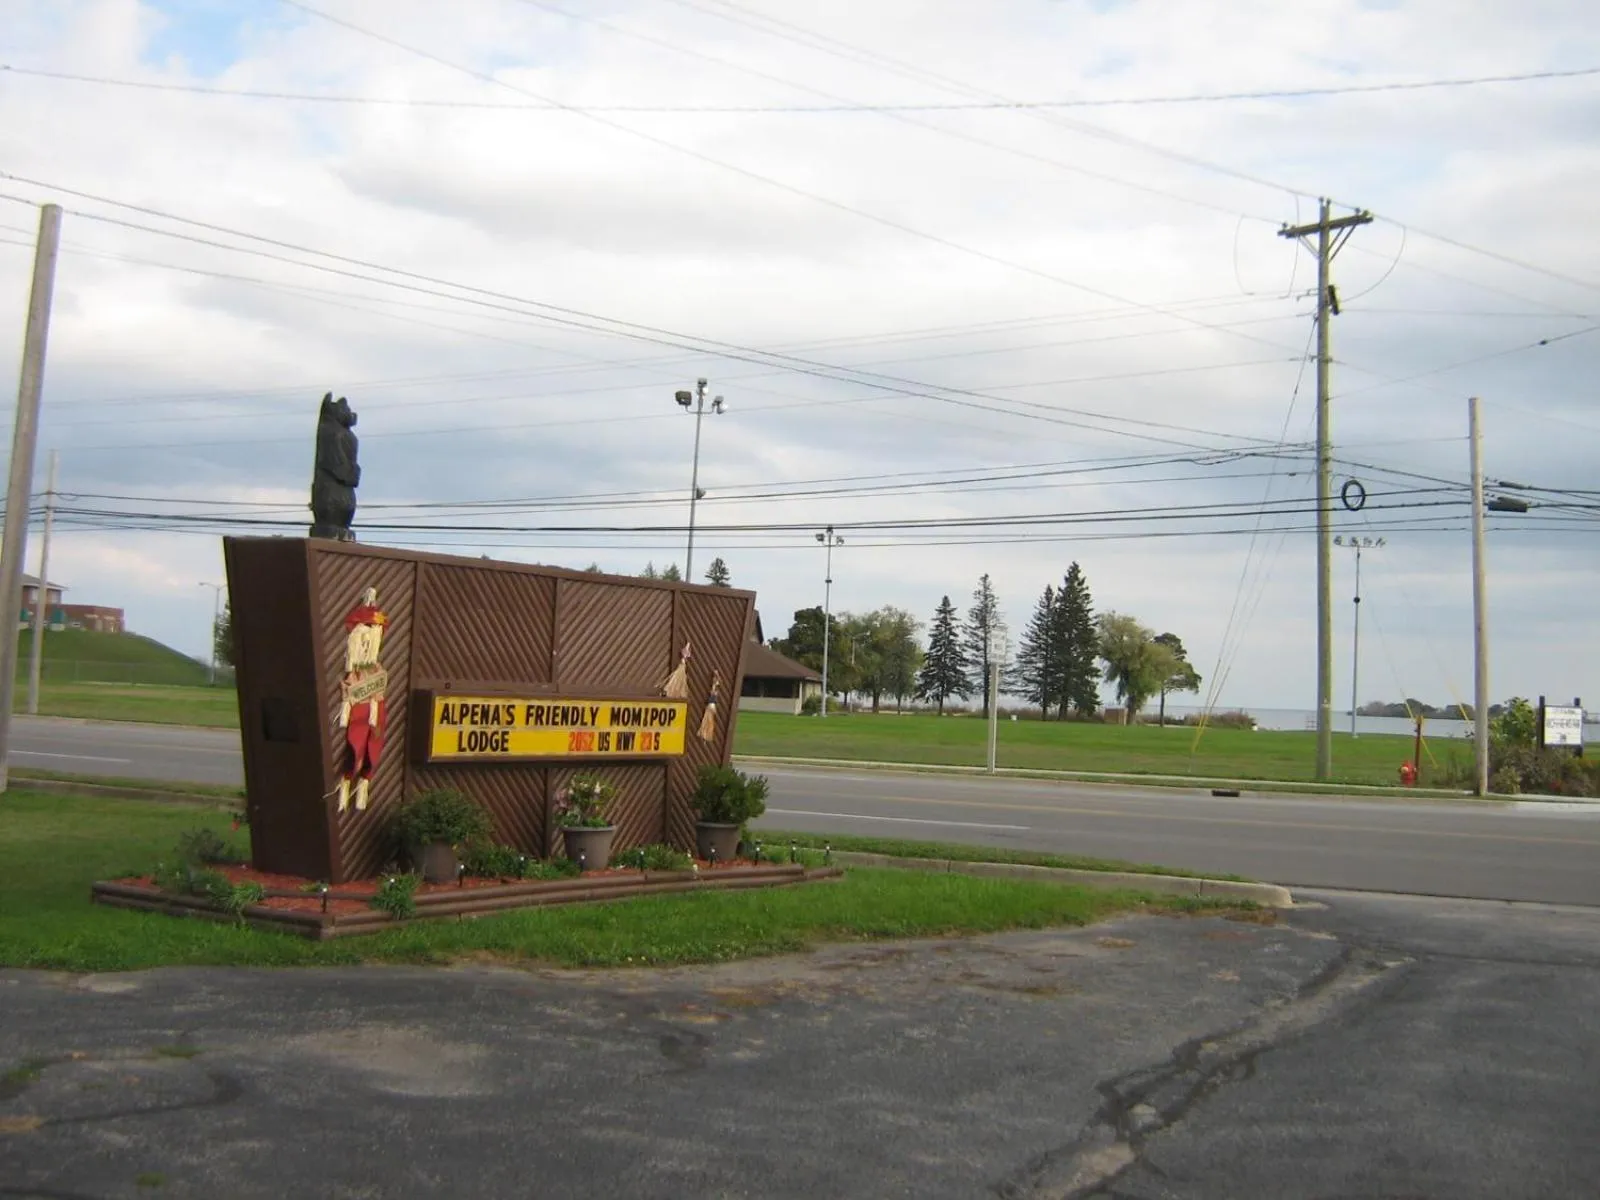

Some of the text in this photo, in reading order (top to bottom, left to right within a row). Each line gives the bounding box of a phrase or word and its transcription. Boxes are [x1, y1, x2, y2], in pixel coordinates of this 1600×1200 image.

[440, 703, 516, 726] ALPENA'S
[526, 705, 600, 727] FRIENDLY
[457, 731, 510, 752] LODGE
